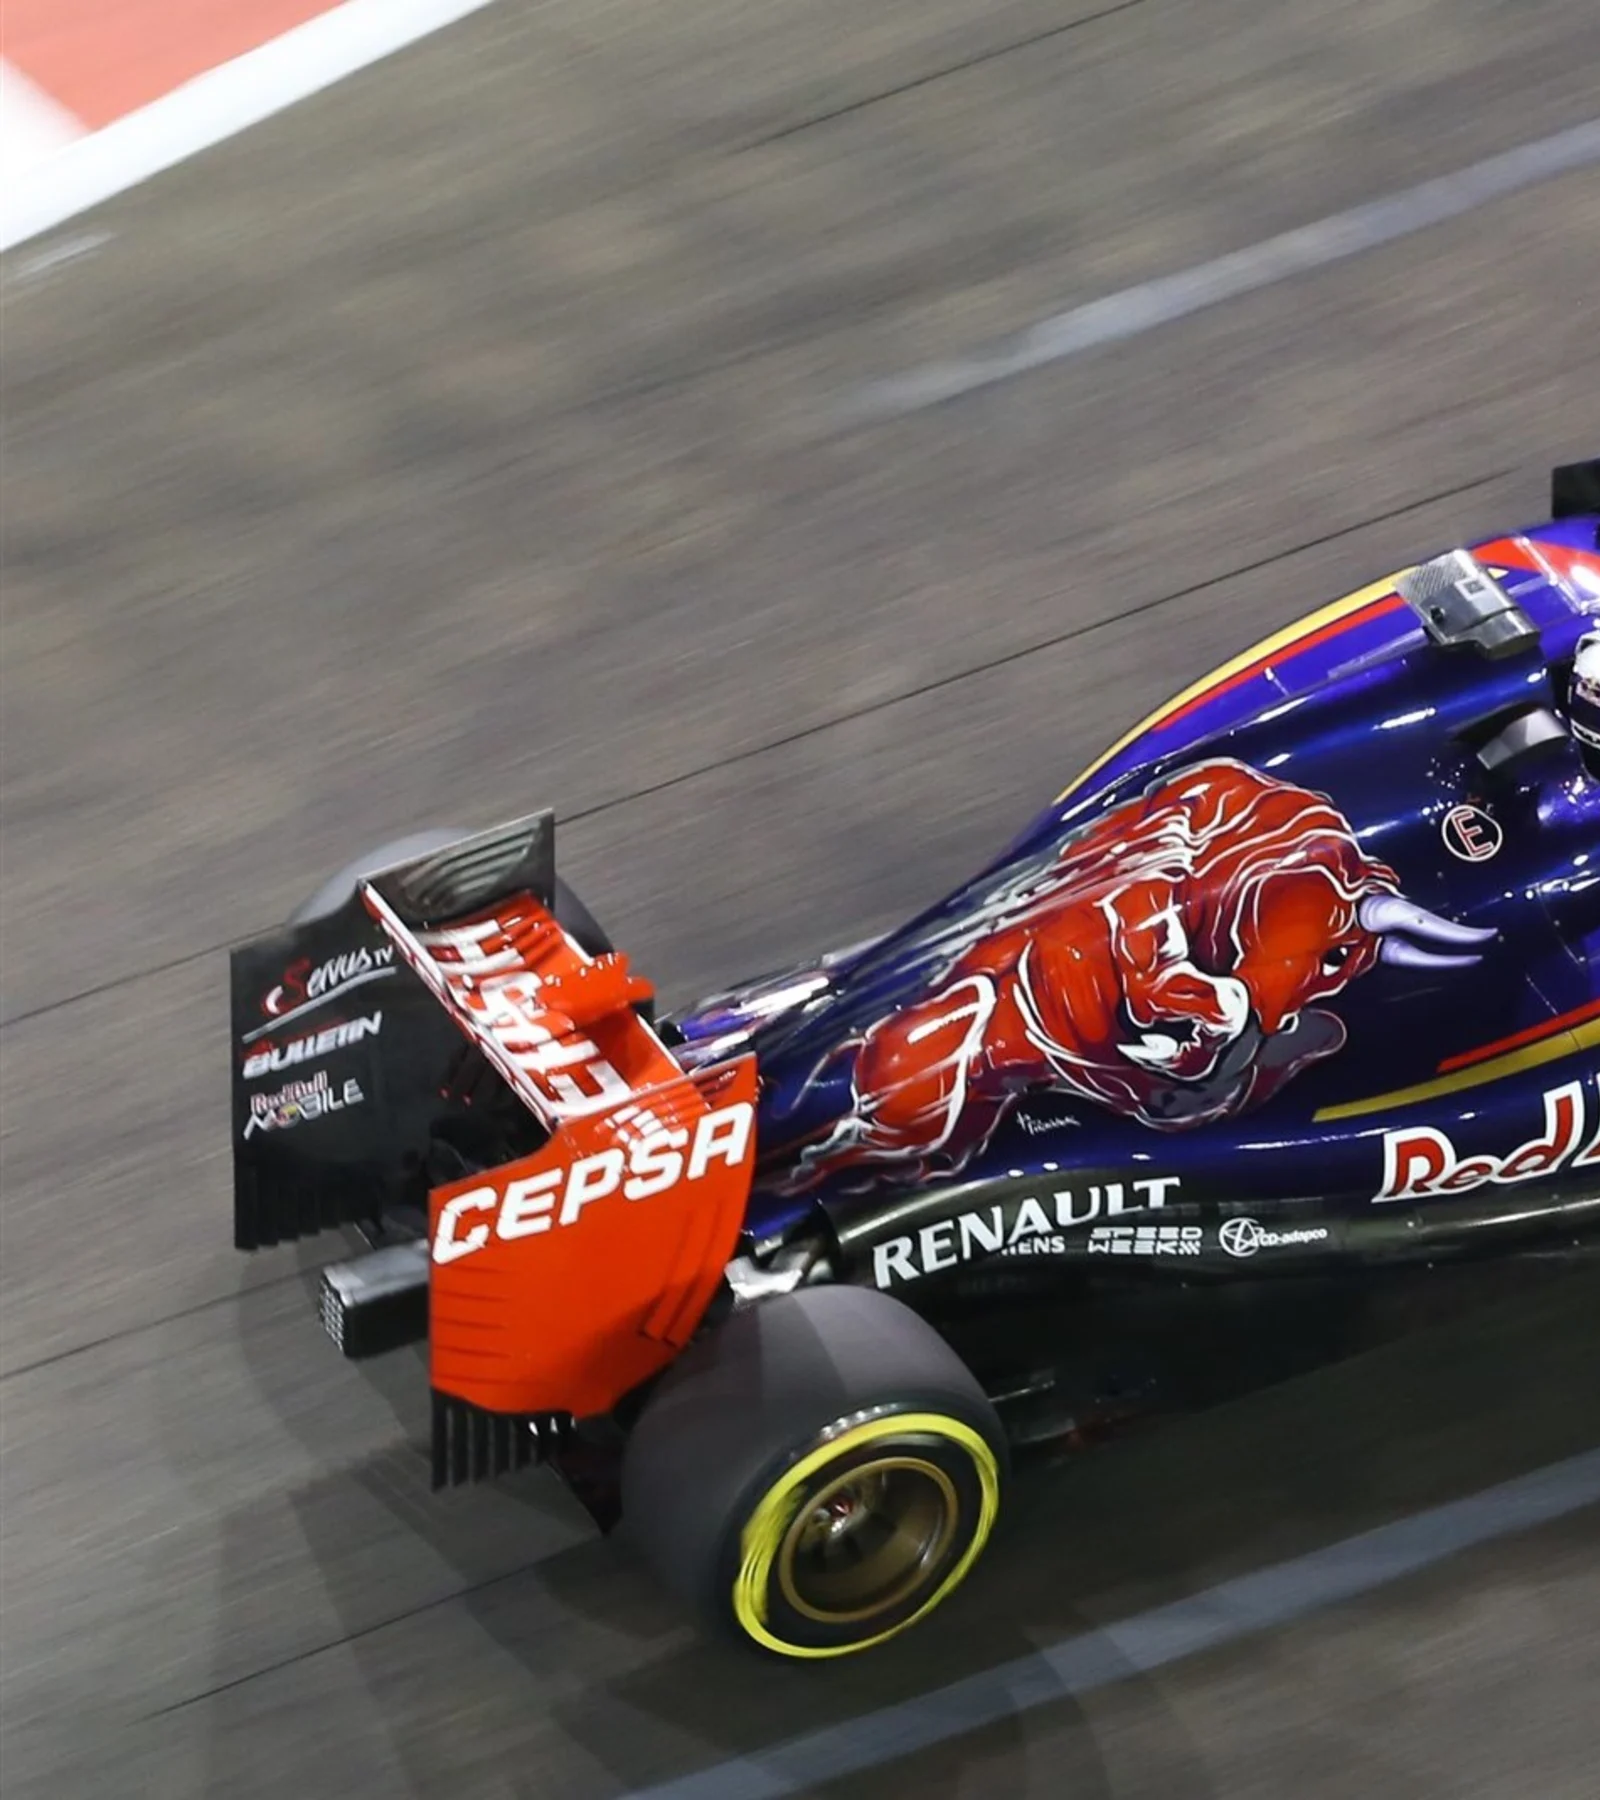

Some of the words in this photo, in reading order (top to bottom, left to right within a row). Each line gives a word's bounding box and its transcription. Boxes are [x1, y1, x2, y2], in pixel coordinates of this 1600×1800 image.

[1451, 809, 1495, 858] E
[242, 1010, 383, 1080] BULLETIN
[432, 1102, 756, 1266] CEPSA
[873, 1176, 1181, 1290] RENAULT
